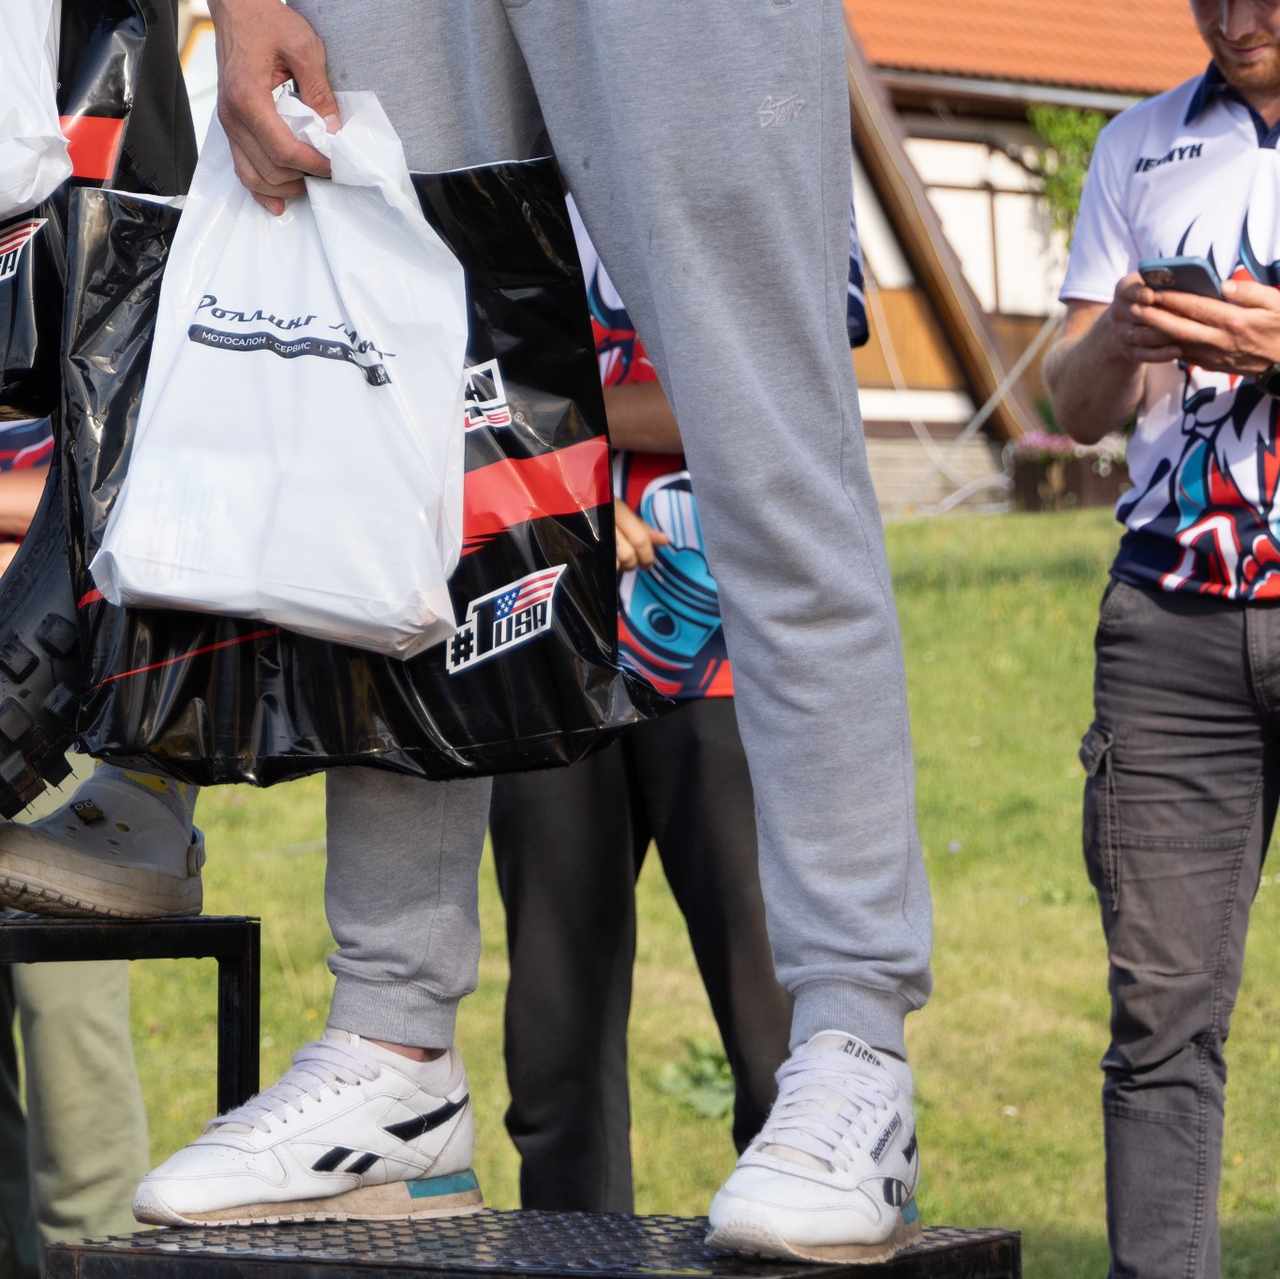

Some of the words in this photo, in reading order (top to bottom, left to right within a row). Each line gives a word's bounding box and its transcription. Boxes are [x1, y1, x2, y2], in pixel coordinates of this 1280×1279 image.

[201, 330, 267, 347] МОТОСАЛОН
[274, 341, 312, 354] СЕРВИС
[494, 600, 549, 649] USA
[869, 1127, 893, 1163] Reebok
